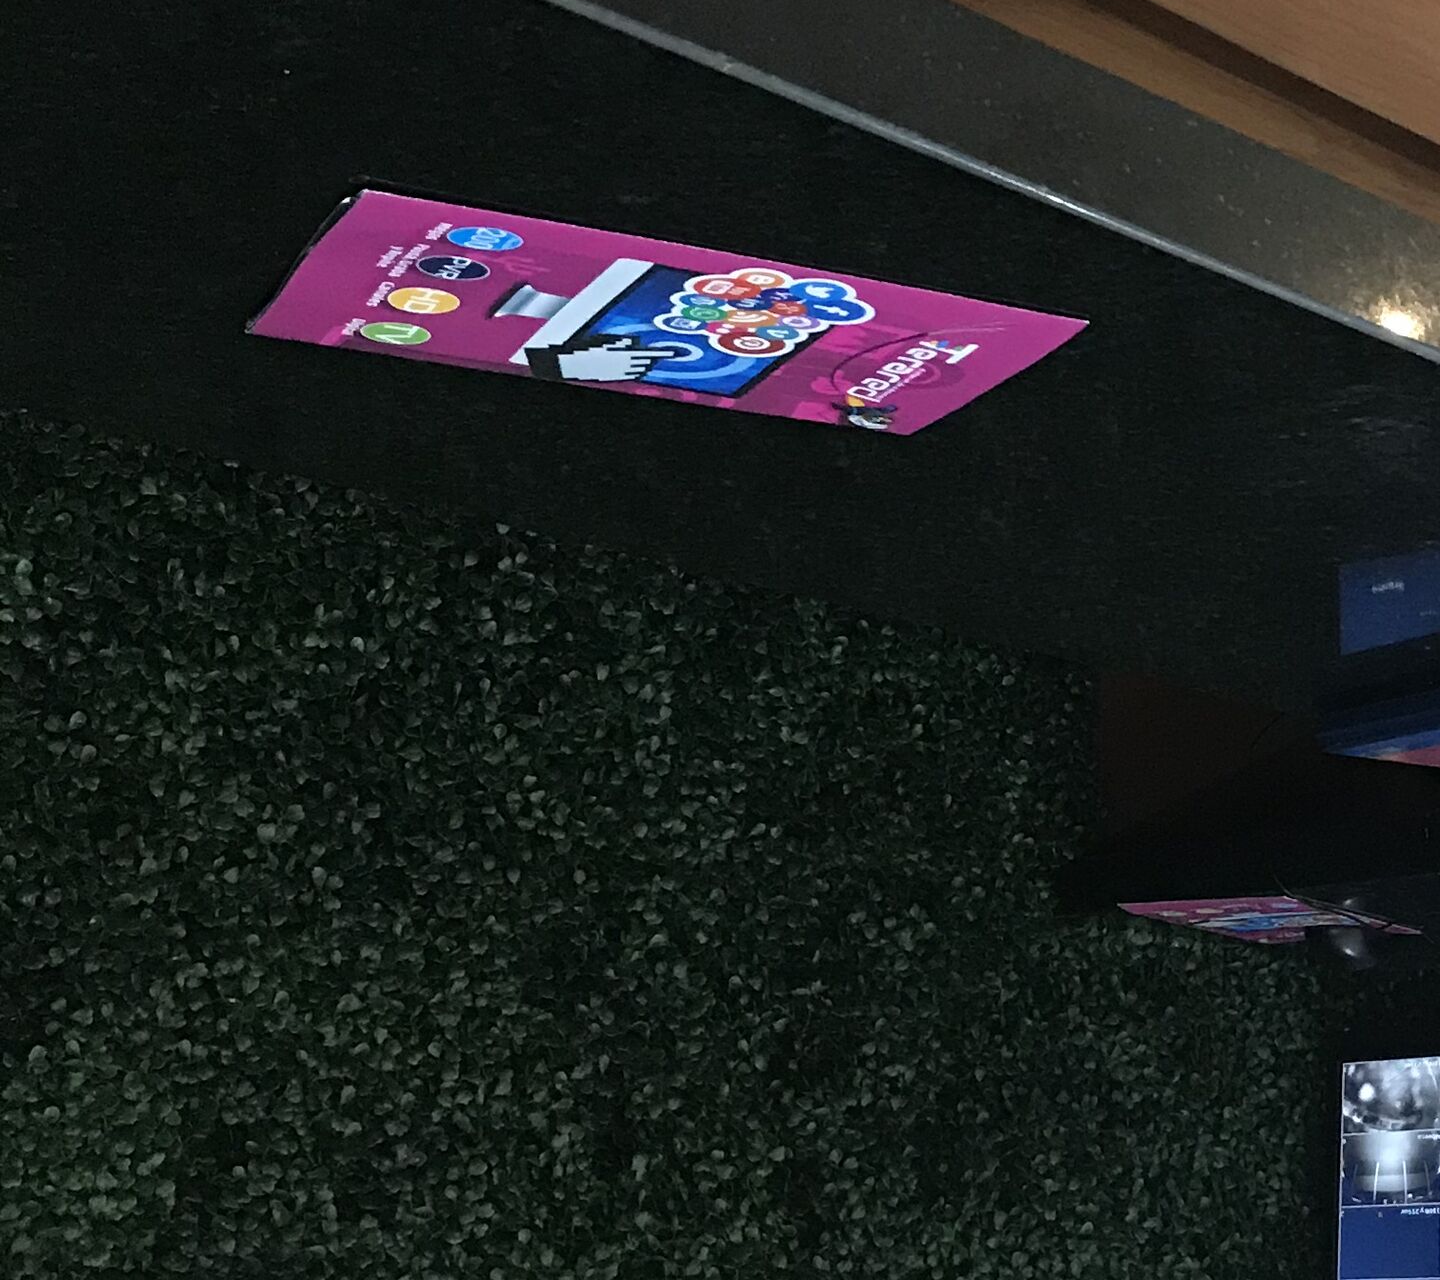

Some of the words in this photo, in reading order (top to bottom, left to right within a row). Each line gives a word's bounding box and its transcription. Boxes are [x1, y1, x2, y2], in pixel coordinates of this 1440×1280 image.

[464, 228, 507, 250] 200
[435, 256, 472, 280] PVR
[401, 288, 449, 313] HD
[375, 324, 418, 345] TV
[846, 341, 980, 403] Terared
